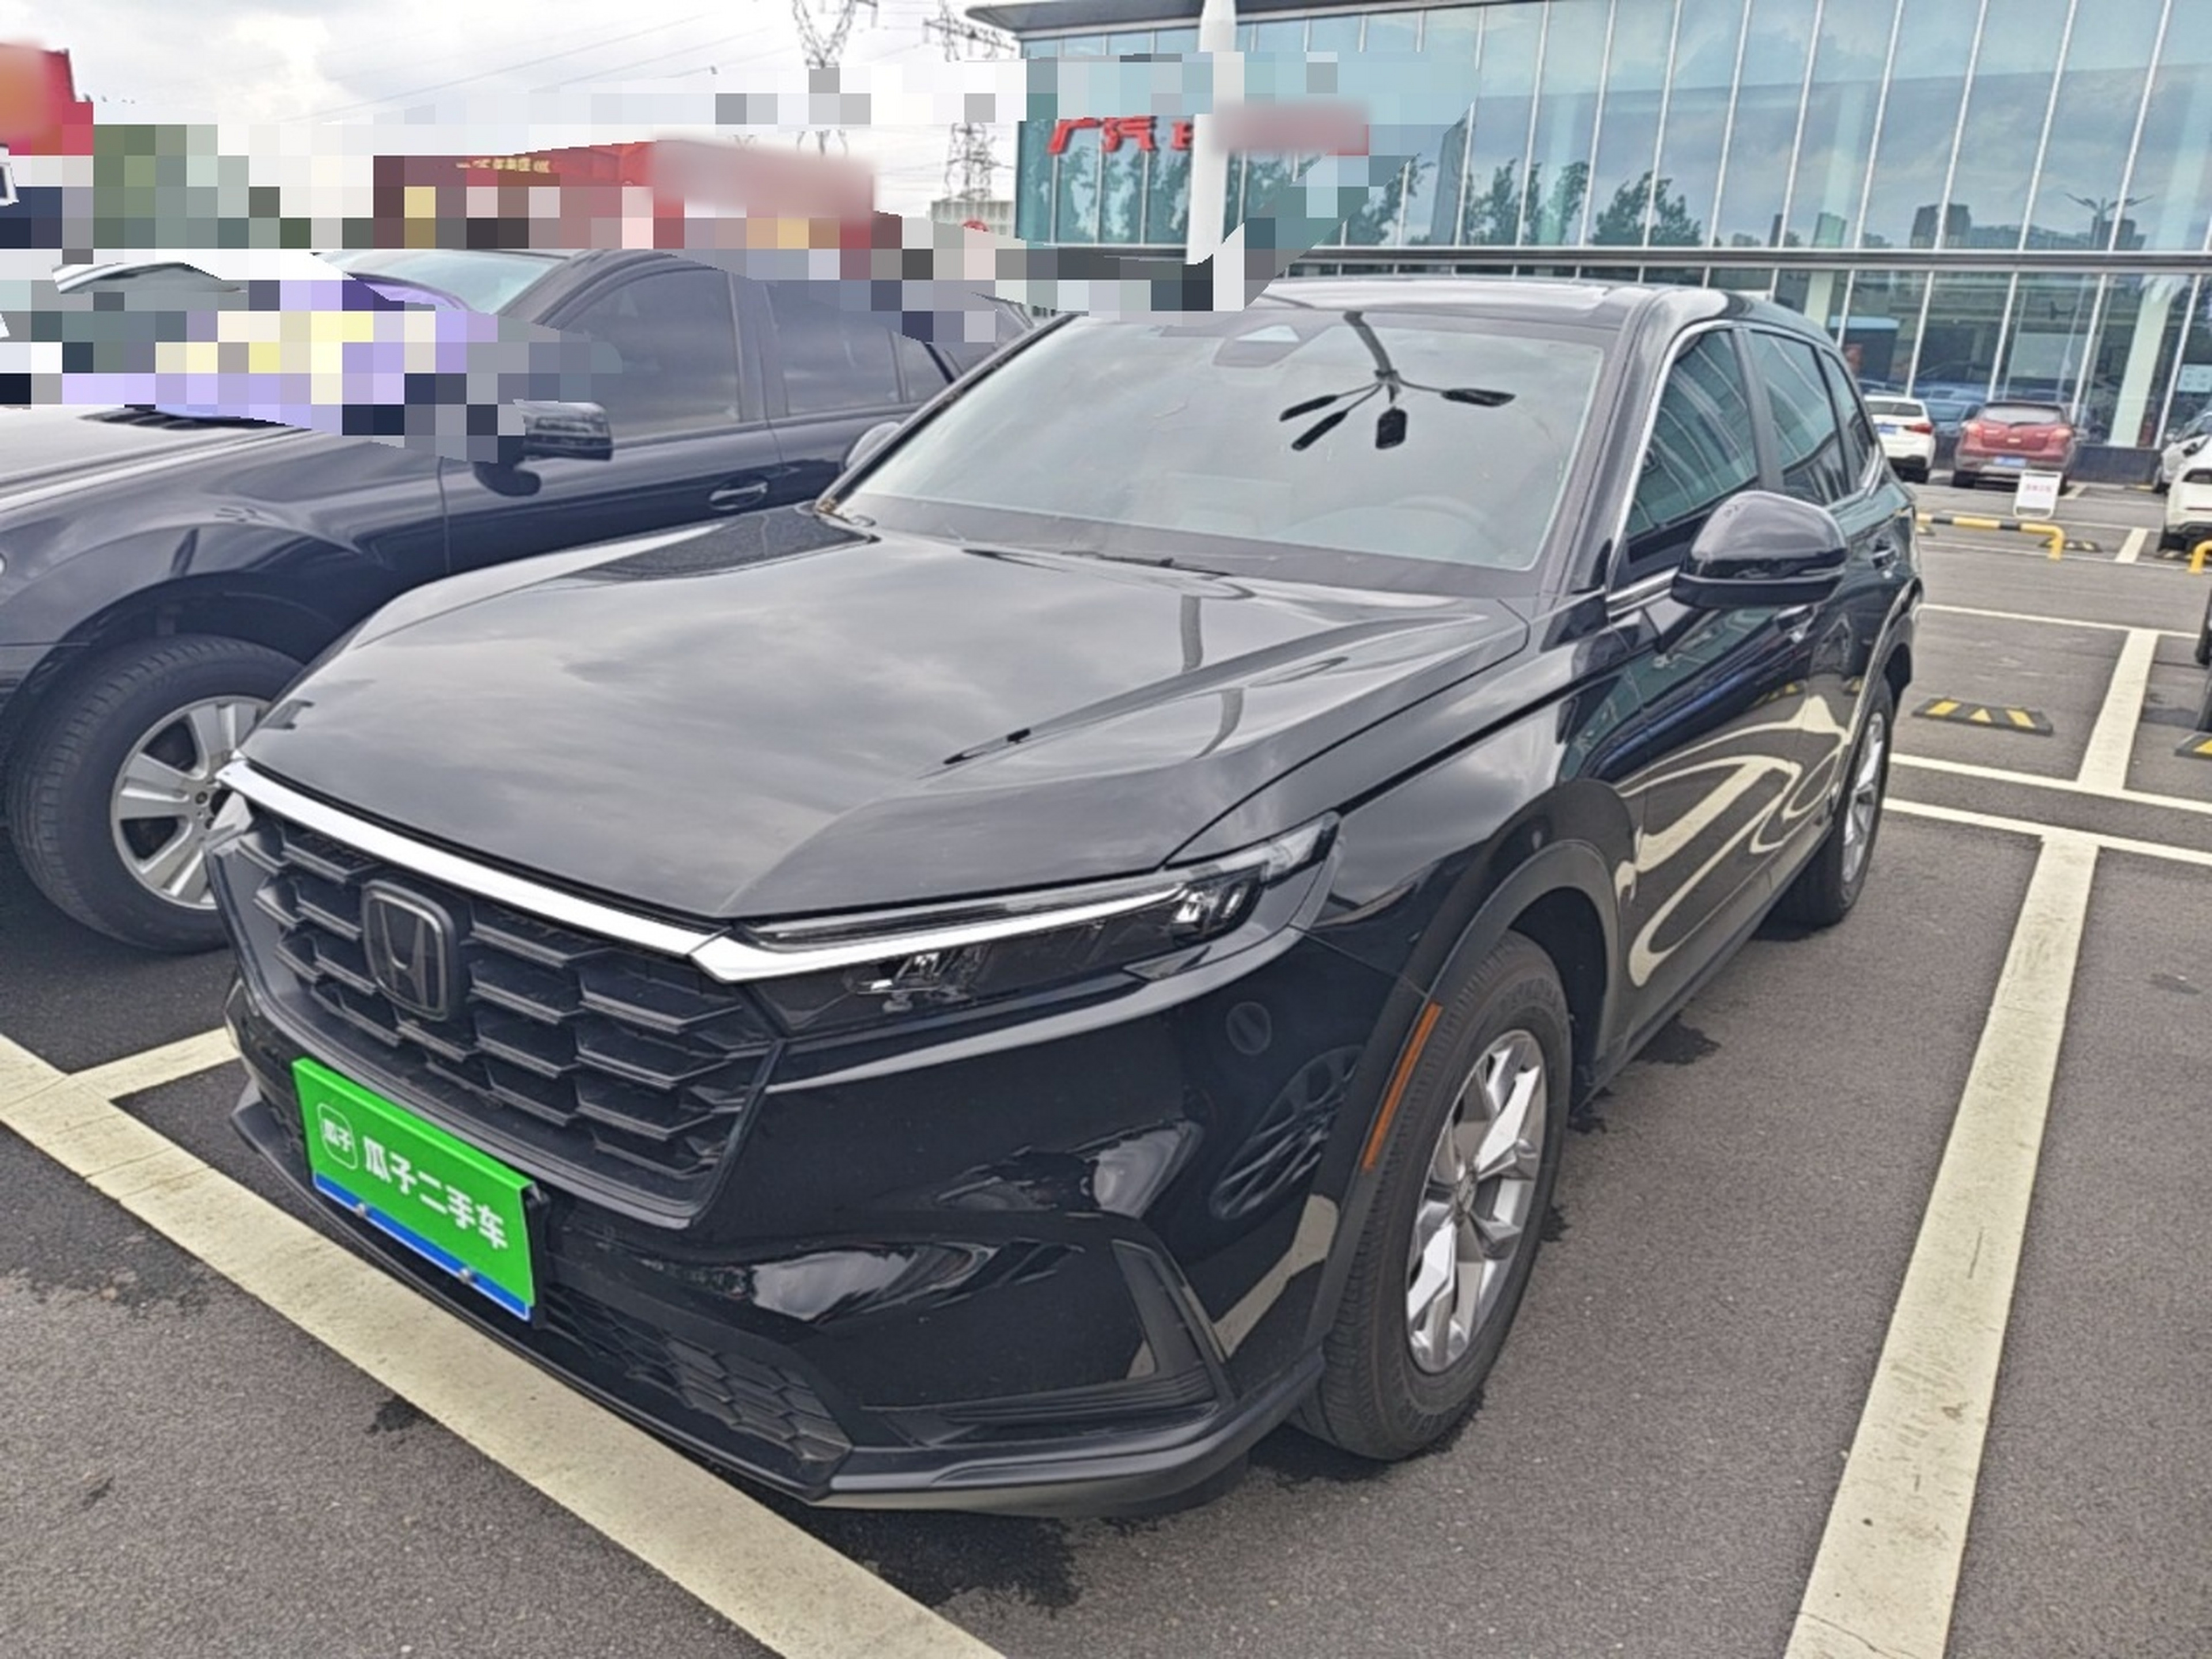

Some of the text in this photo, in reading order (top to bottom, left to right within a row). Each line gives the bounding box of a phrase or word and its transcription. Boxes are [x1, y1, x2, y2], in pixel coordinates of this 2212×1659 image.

[323, 1118, 354, 1152] 瓜子
[362, 1135, 509, 1249] 瓜子二手车
